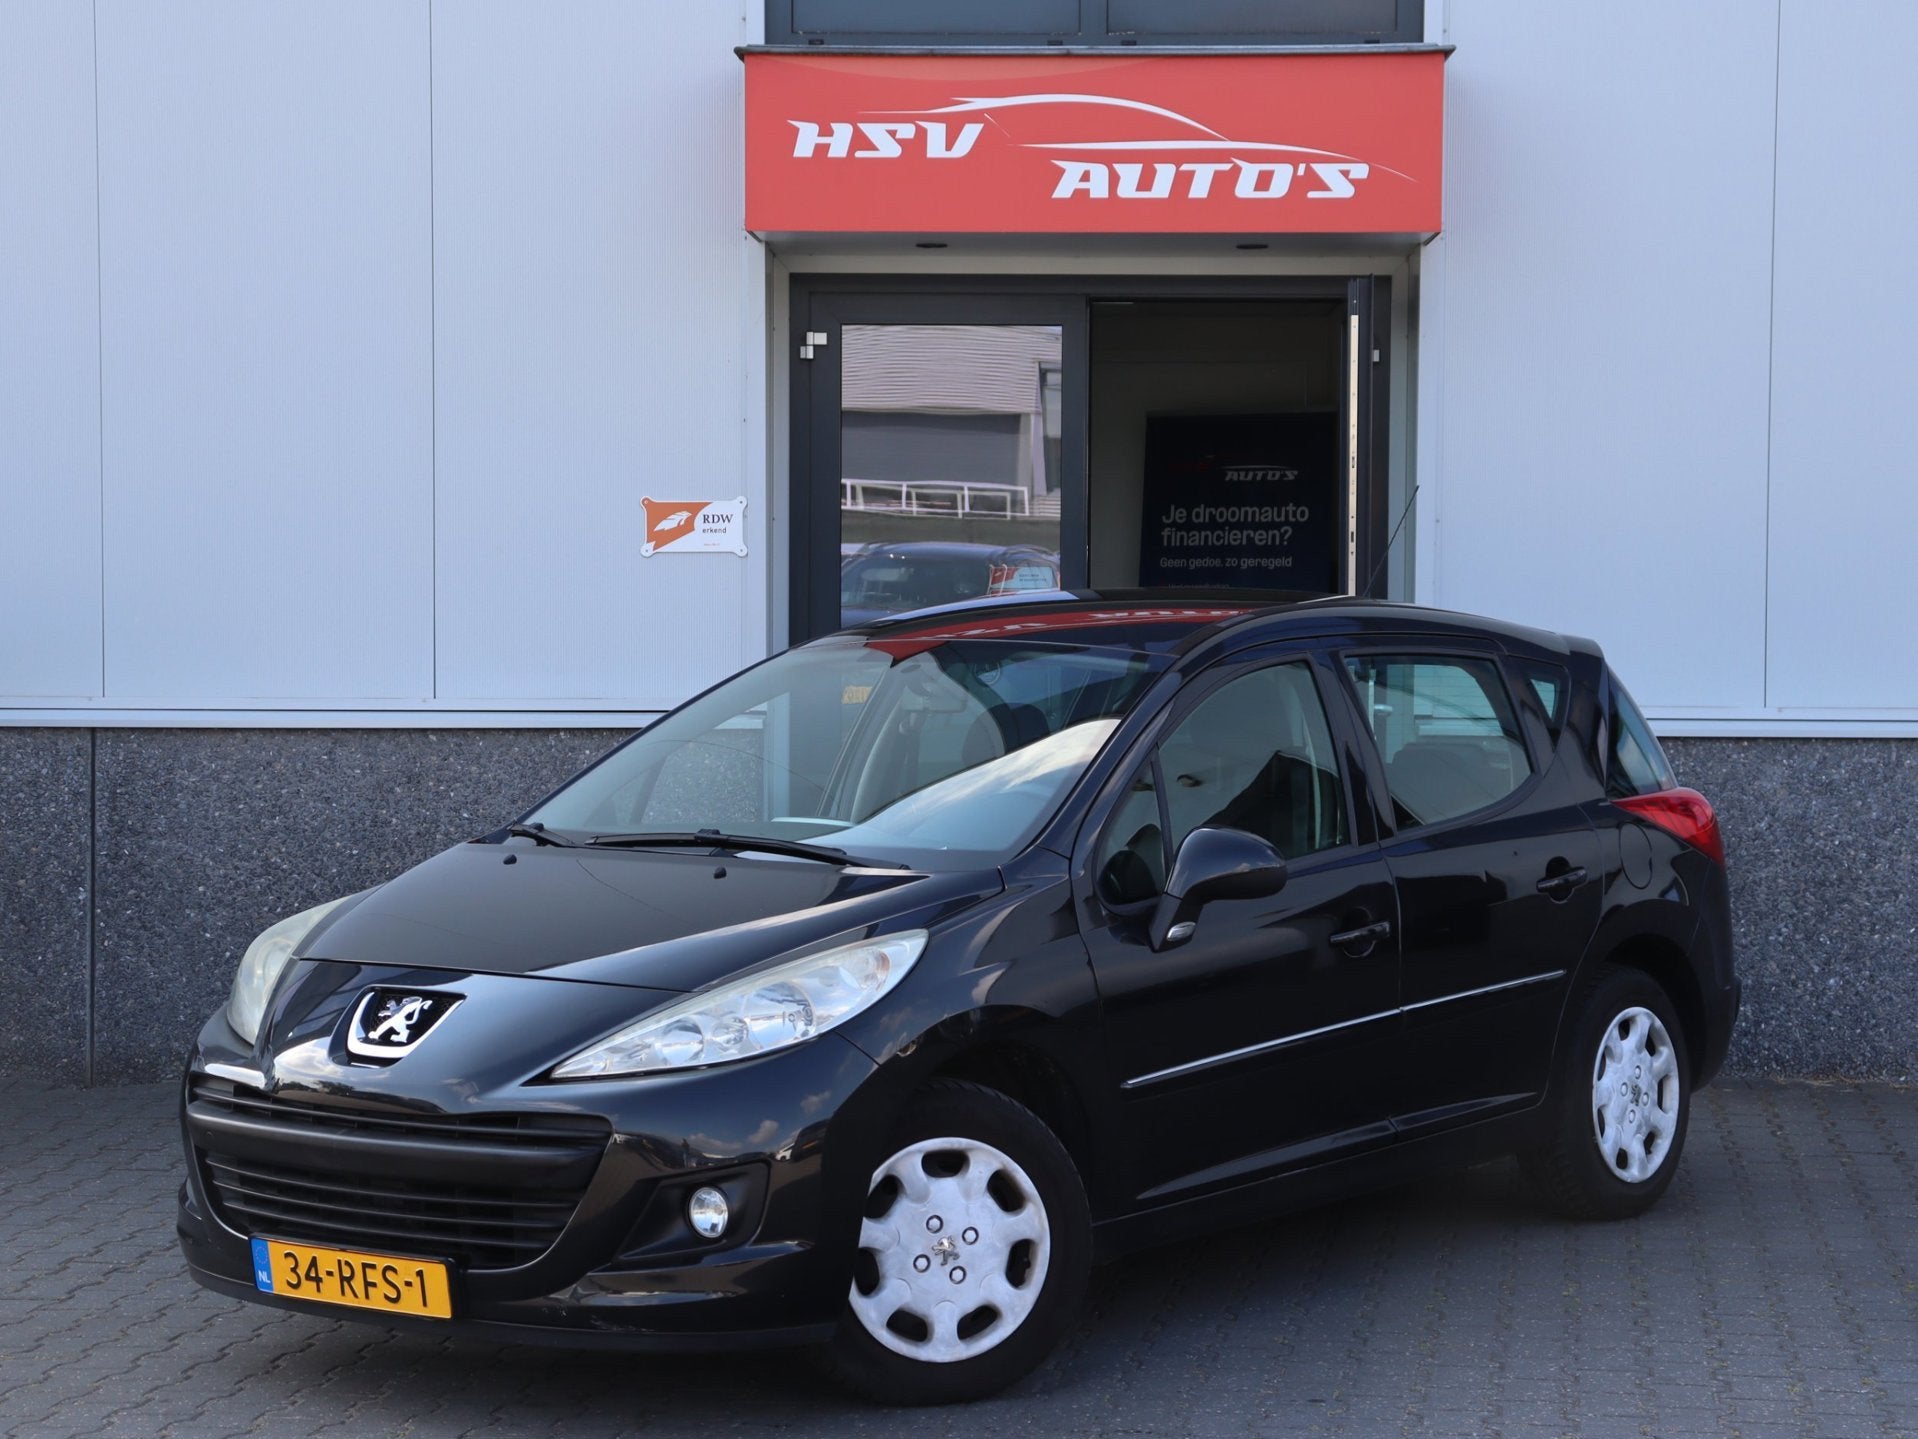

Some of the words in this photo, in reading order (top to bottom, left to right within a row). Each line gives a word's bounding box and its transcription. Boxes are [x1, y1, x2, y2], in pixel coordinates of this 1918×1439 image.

[786, 120, 985, 158] HSV
[1050, 157, 1370, 199] AUTO'S
[1224, 470, 1299, 481] AUTO'S
[702, 514, 734, 524] RDW
[1161, 504, 1187, 523] Je
[1191, 503, 1309, 523] droomauto
[1161, 526, 1293, 546] financieren?
[1160, 557, 1187, 568] Geen
[1225, 557, 1238, 567] zo
[1240, 556, 1293, 570] geregeld
[258, 1270, 271, 1284] NL
[283, 1251, 428, 1308] 34-RFS-1
